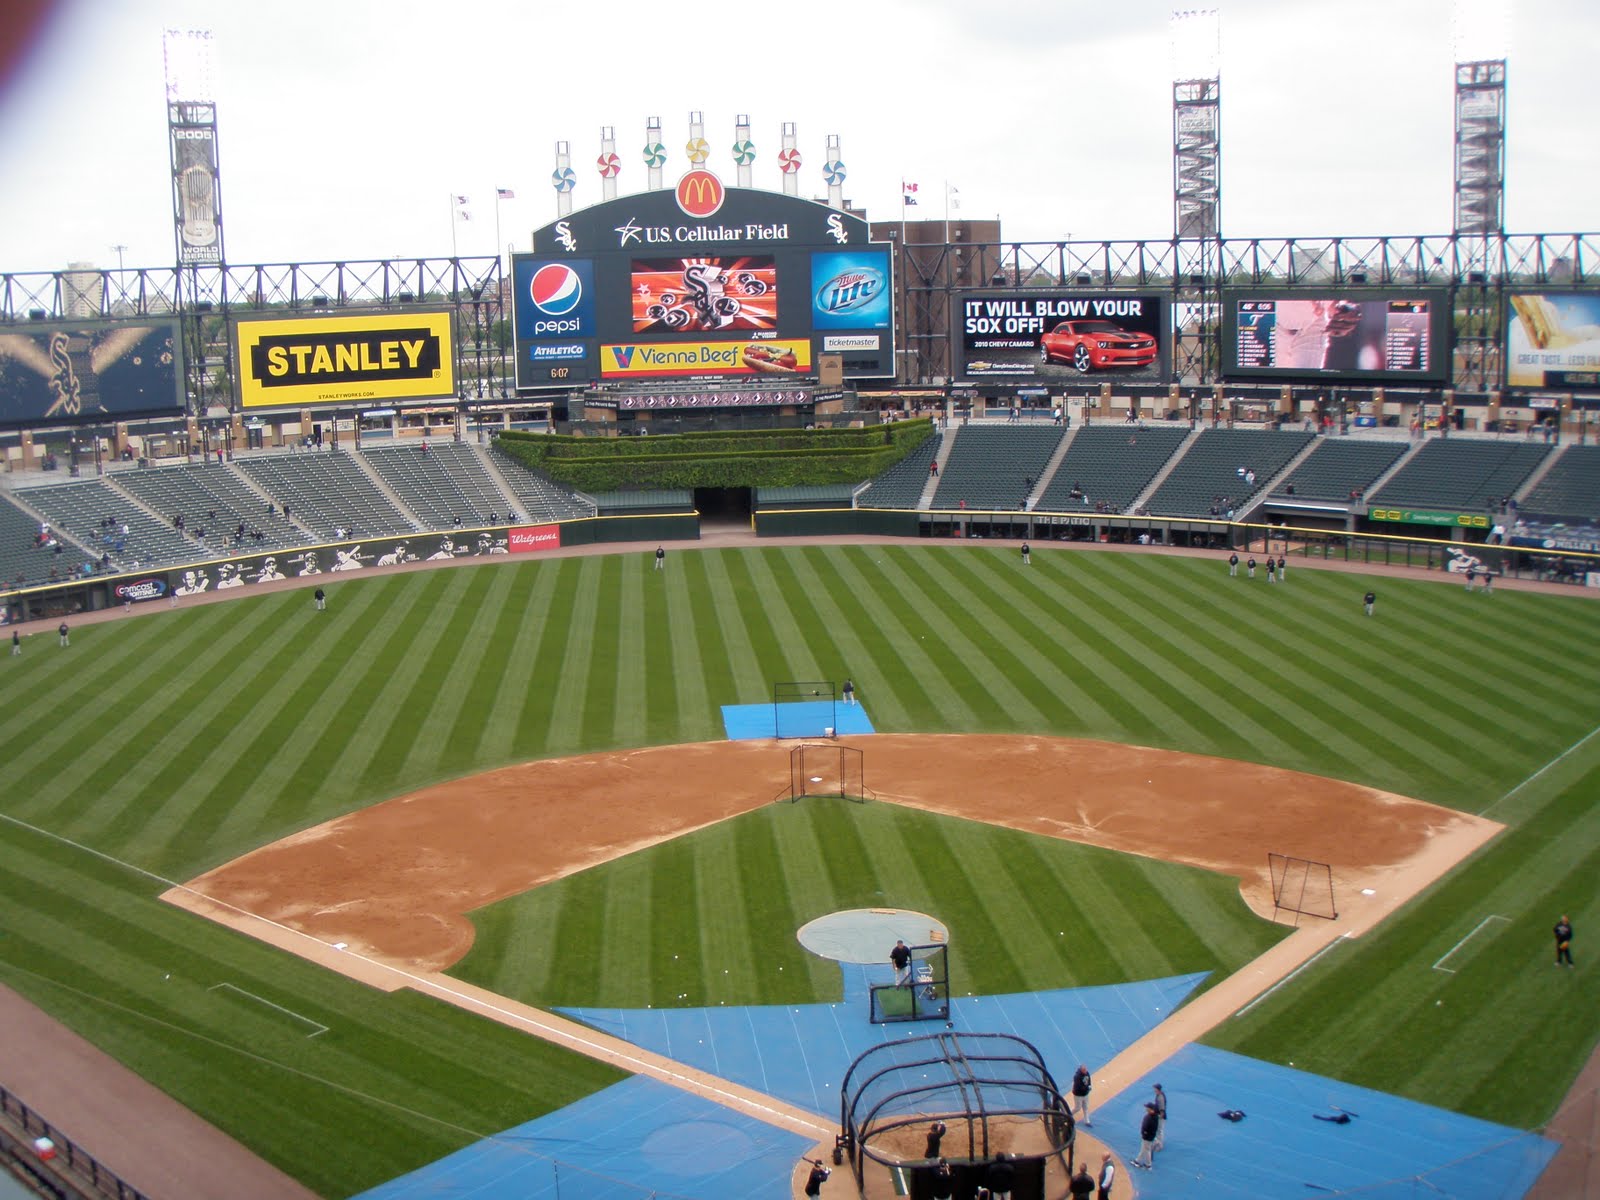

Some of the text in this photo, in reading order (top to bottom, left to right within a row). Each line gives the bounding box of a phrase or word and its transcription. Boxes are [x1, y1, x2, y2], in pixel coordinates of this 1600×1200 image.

[176, 130, 213, 140] 2005
[646, 223, 789, 243] U.S. Cellular Field
[183, 246, 219, 254] WORLD
[828, 280, 877, 311] Lite
[966, 300, 1142, 317] IT WILL BLOW YOUR
[535, 317, 580, 335] pepsi
[966, 317, 1045, 334] SOX OFF!
[828, 338, 876, 347] ticketmaster
[267, 339, 425, 377] STANLEY
[639, 345, 739, 367] Vienna Beef
[551, 368, 569, 378] 6:07
[318, 391, 375, 400] STANLEYWORKS.COM
[1036, 515, 1090, 526] THE PATIO
[511, 532, 558, 545] Walgreens
[119, 582, 153, 594] comcast
